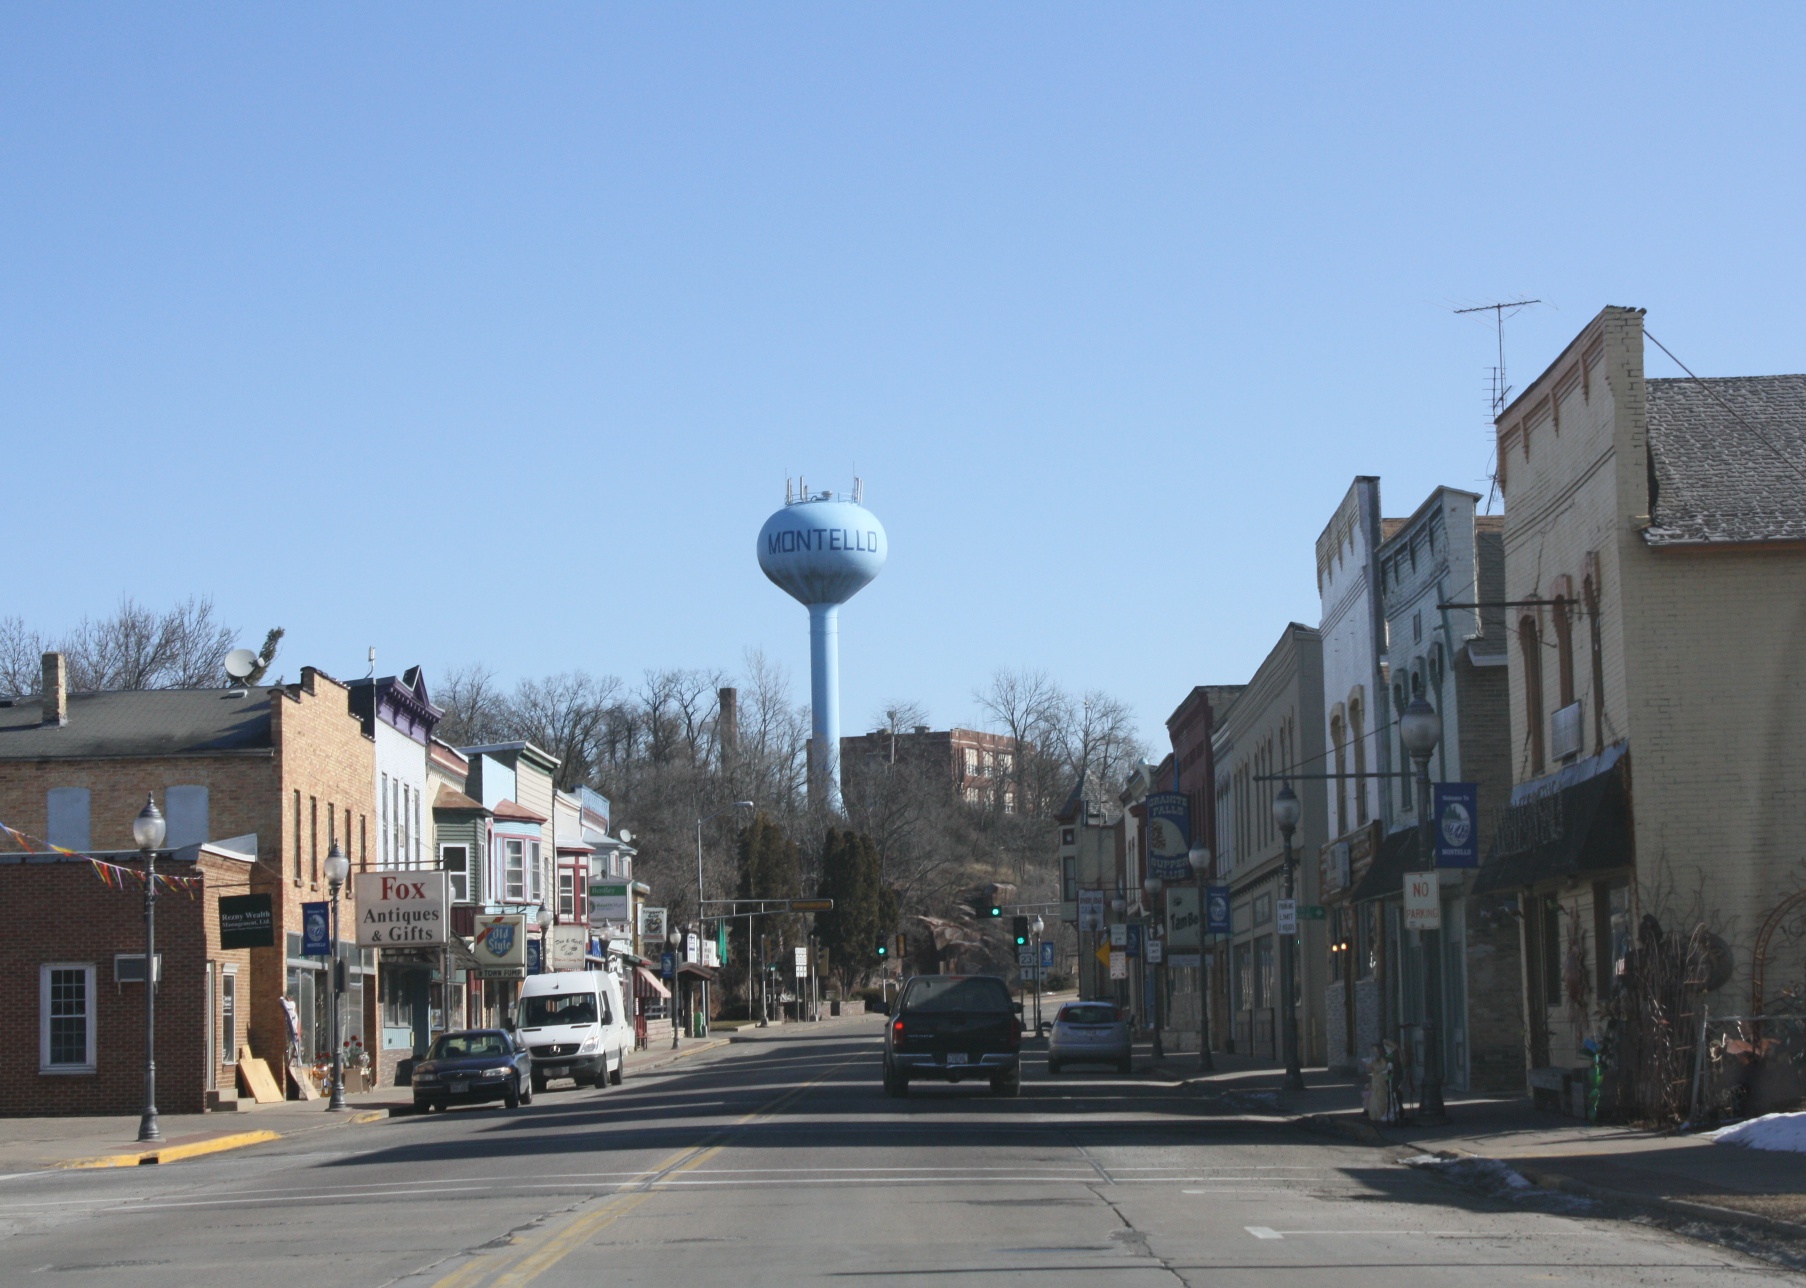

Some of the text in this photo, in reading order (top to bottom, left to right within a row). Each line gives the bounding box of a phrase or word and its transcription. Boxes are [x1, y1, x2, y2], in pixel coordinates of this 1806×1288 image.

[768, 528, 878, 555] MONTELLO
[1149, 795, 1188, 807] GRANITE
[1152, 806, 1185, 817] FALLS
[1441, 848, 1472, 856] MONTELLO
[1151, 857, 1189, 869] SUPPER
[1155, 868, 1185, 879] CLUB
[1413, 881, 1429, 898] NO
[363, 907, 439, 925] Antiques
[1406, 908, 1438, 919] PARKING
[371, 926, 433, 942] & Gifts
[492, 928, 509, 939] Old
[488, 939, 511, 954] Style
[1021, 955, 1032, 963] 23
[484, 969, 502, 977] TOWN
[504, 969, 522, 977] PUMP
